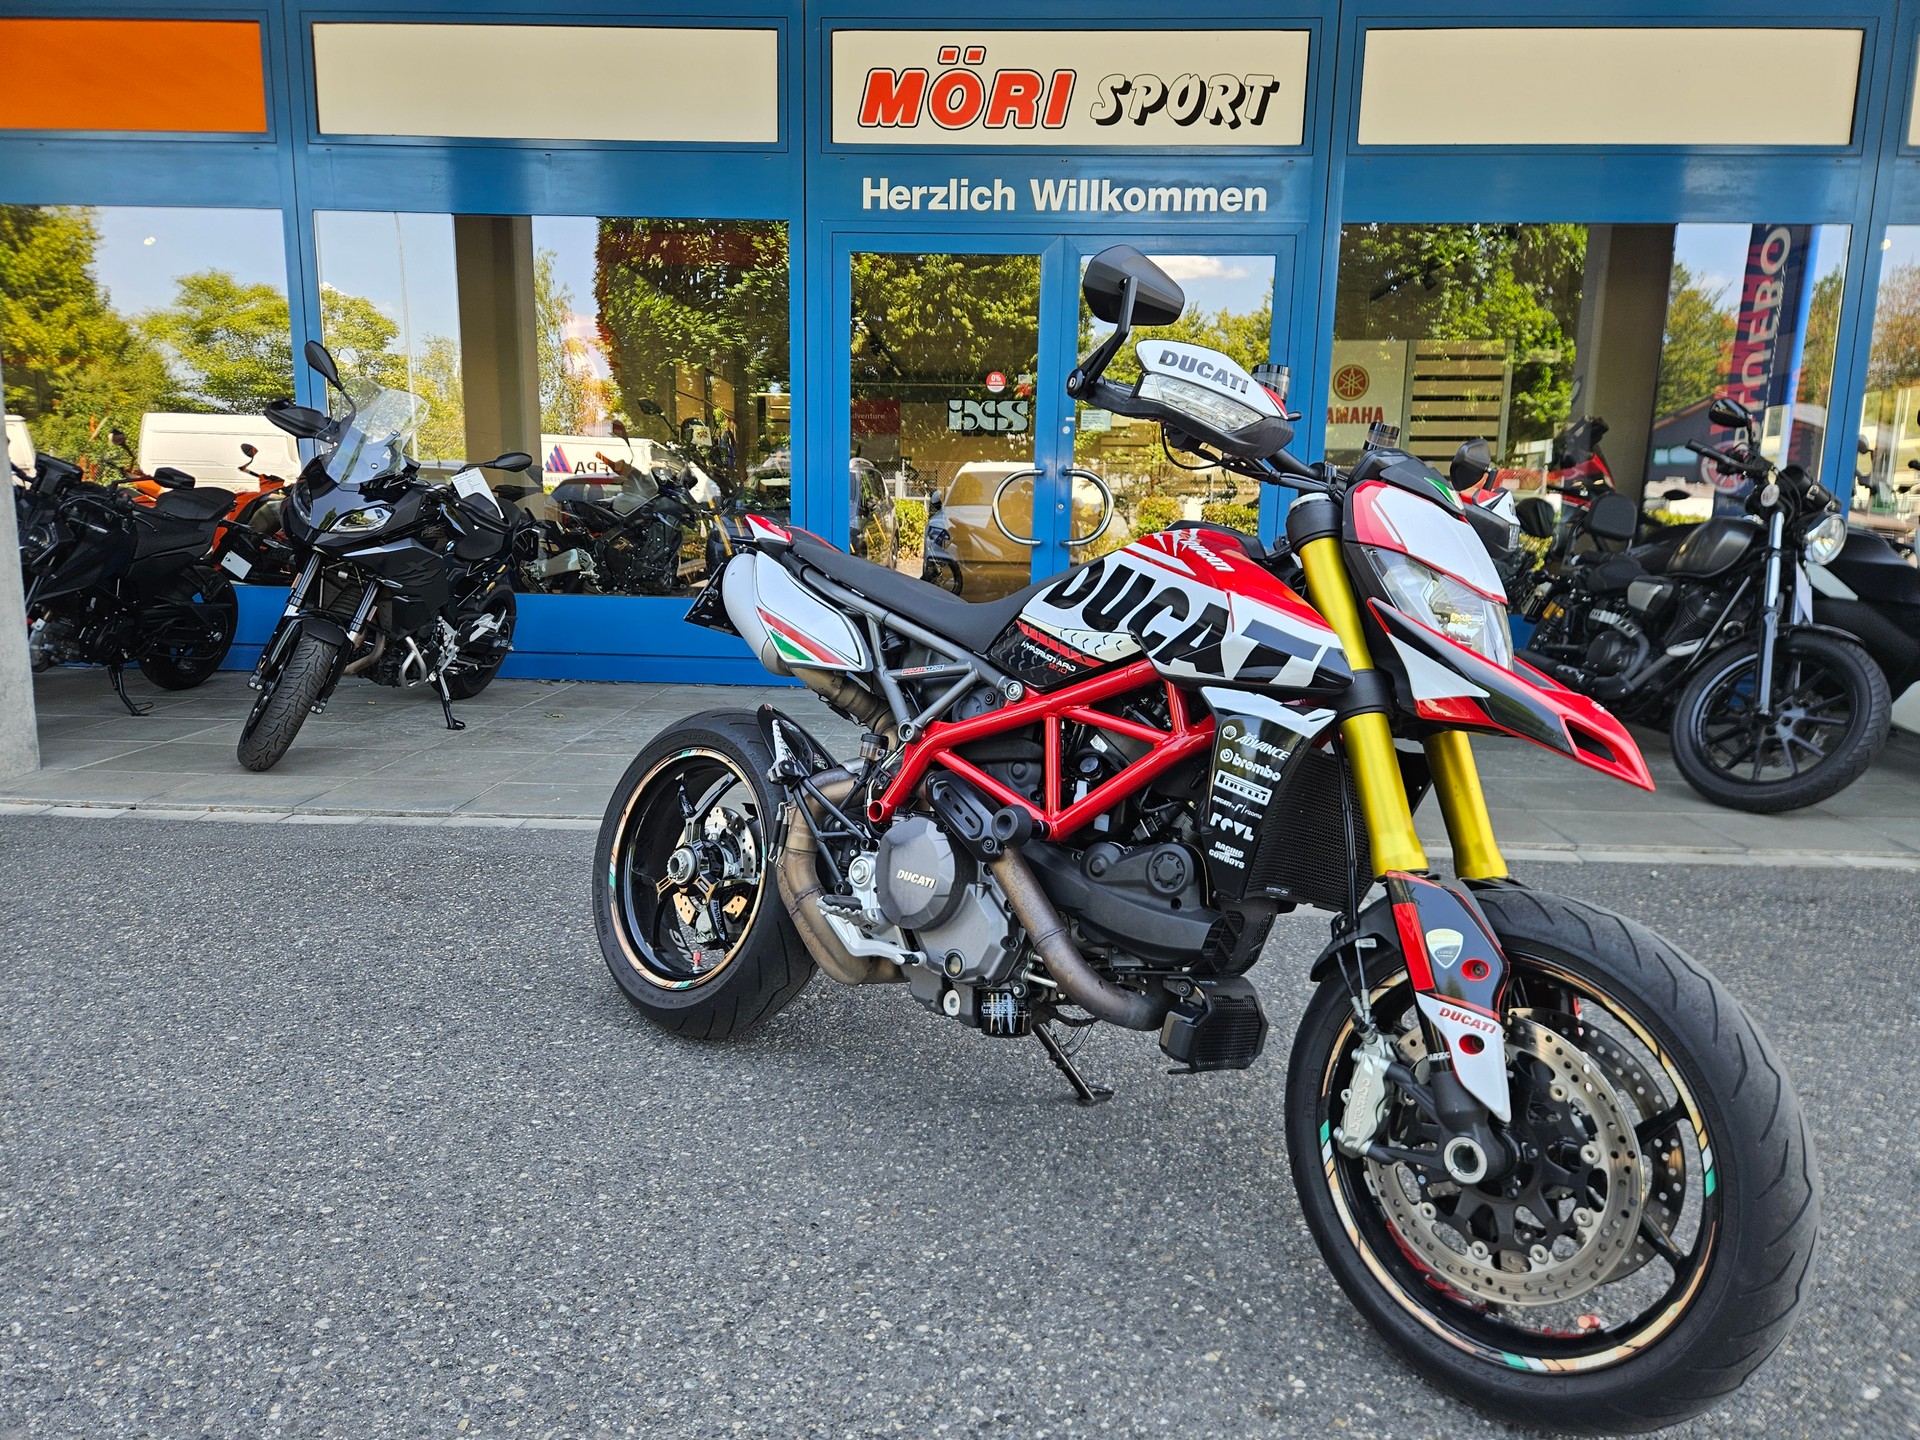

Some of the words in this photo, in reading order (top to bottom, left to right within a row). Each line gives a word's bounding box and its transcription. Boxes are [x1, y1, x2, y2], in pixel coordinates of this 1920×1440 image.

[858, 46, 1077, 130] MÖRI
[1090, 73, 1280, 129] SPORT
[862, 178, 1015, 211] Herzlich
[1030, 178, 1267, 212] Willkommen
[1158, 349, 1249, 395] DUCATI
[852, 412, 886, 420] dventure
[1326, 406, 1385, 425] AMAHA
[1042, 558, 1354, 688] DUCATI
[1234, 735, 1292, 761] ADVANCE
[1232, 752, 1282, 782] brembo
[1208, 848, 1246, 870] COWBOYS
[1214, 841, 1245, 859] RACING
[896, 869, 937, 889] DUCATI
[1439, 1007, 1497, 1034] DUCATI
